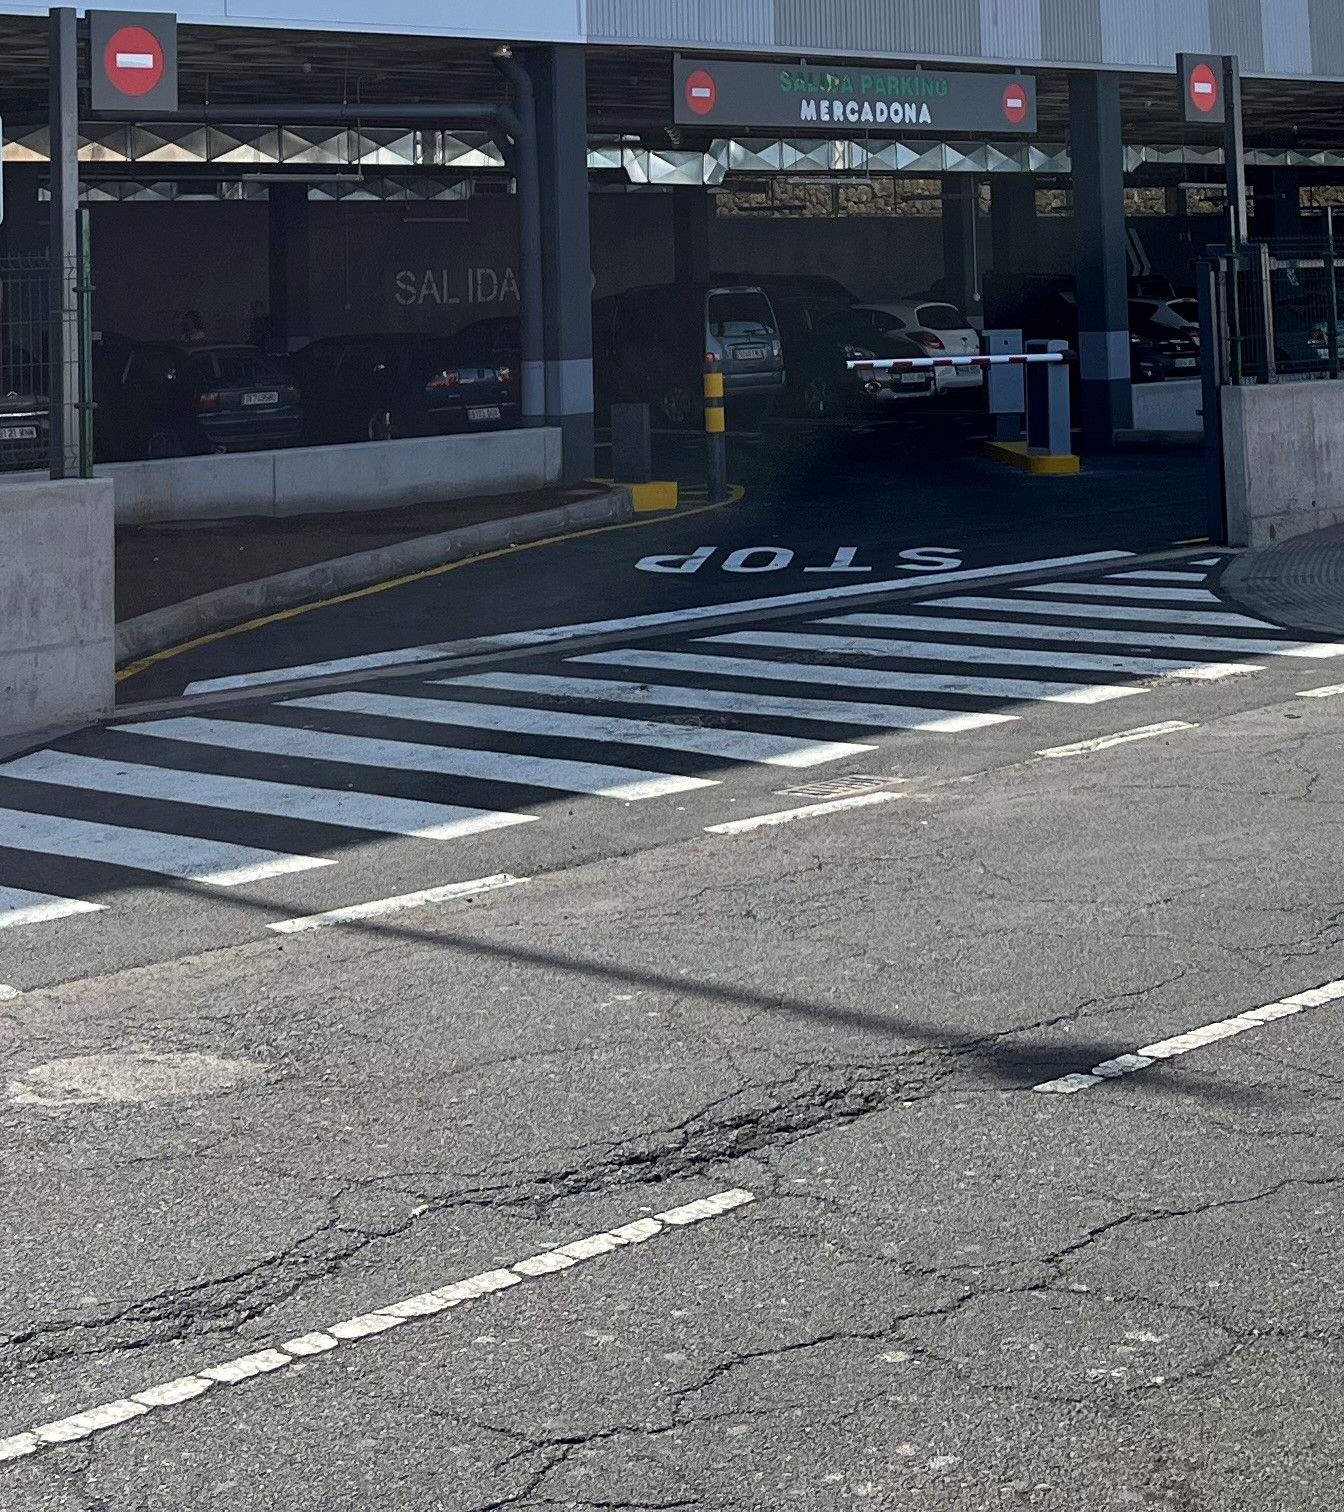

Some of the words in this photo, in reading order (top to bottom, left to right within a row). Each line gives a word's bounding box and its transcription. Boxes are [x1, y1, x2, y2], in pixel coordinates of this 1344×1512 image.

[860, 75, 949, 97] PARKING
[800, 99, 932, 124] MERCADONA
[396, 268, 520, 305] SALIDA
[635, 546, 963, 573] STOP
